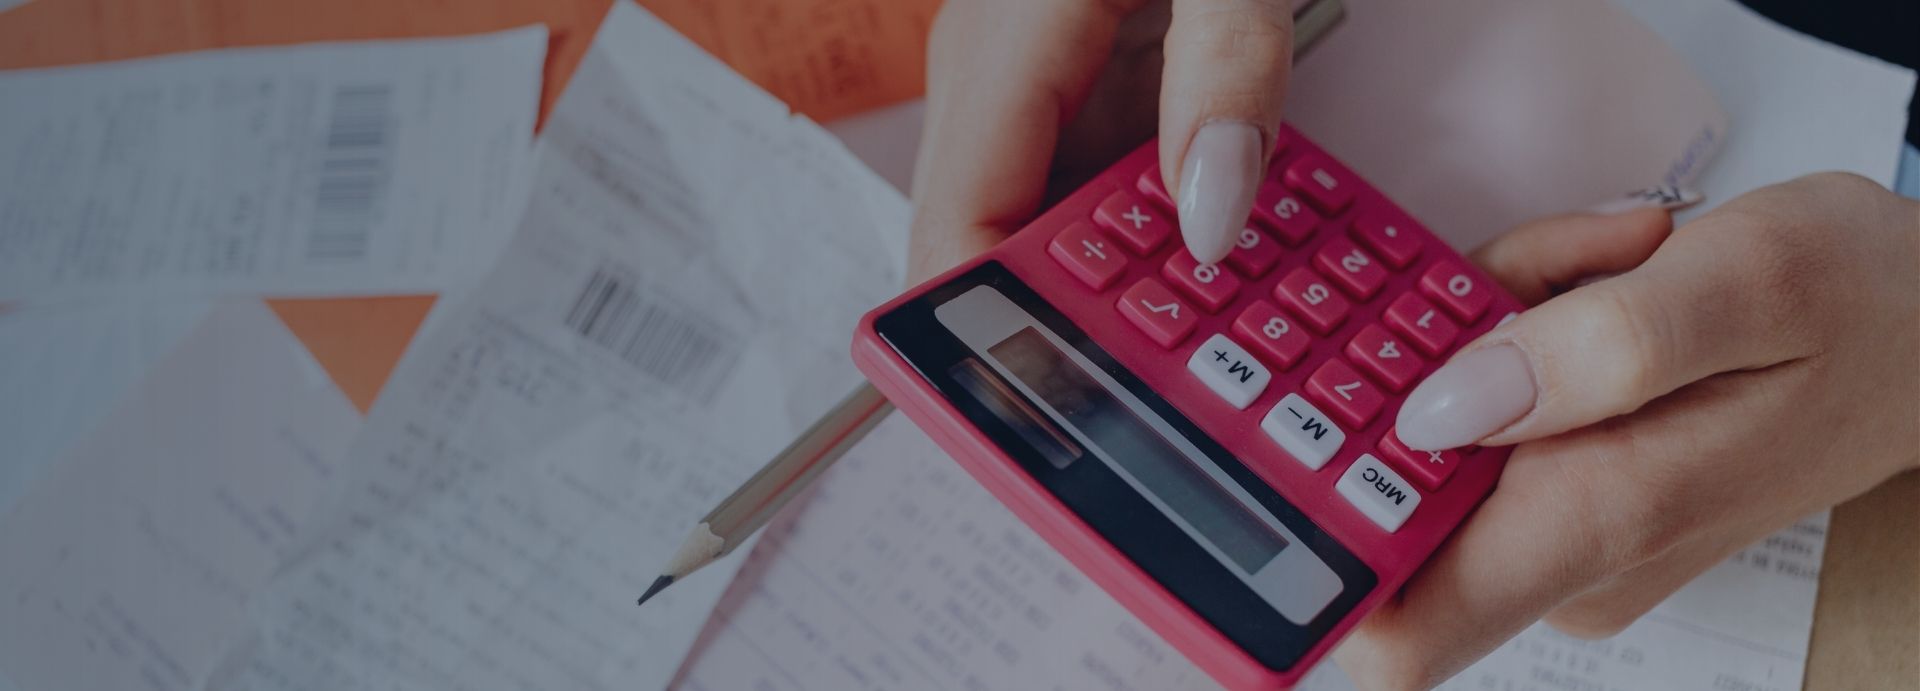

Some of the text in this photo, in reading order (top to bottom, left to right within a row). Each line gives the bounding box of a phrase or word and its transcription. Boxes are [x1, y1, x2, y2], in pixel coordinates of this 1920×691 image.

[1274, 197, 1300, 219] 3
[1236, 228, 1259, 249] 6
[1194, 261, 1220, 284] 9
[1342, 249, 1369, 273] 2
[1301, 283, 1329, 306] 5
[1447, 274, 1473, 297] 0
[1262, 317, 1289, 340] 8
[1416, 309, 1435, 329] 1
[1377, 340, 1401, 359] 4
[1213, 348, 1255, 384] M+
[1334, 381, 1362, 402] 7
[1361, 466, 1408, 506] MRC
